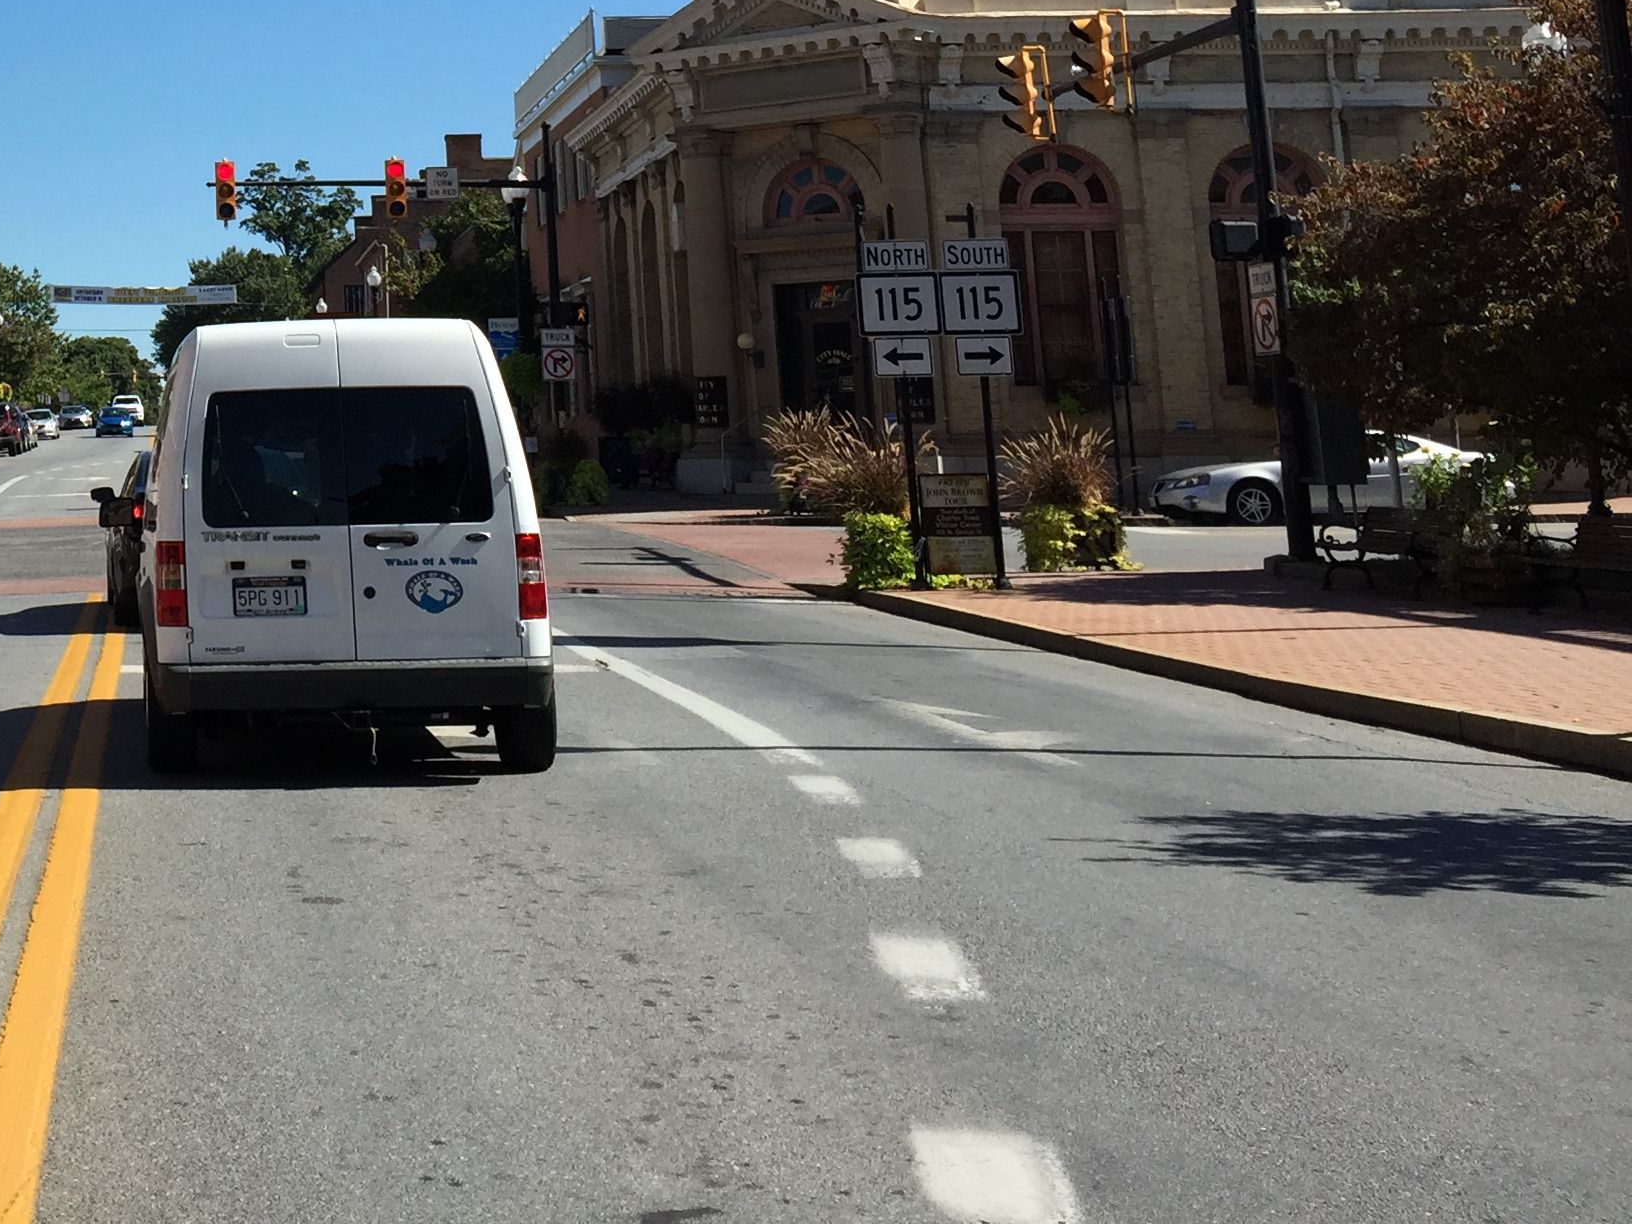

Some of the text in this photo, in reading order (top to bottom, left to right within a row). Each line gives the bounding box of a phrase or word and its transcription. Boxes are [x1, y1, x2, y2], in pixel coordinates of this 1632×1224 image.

[436, 170, 448, 178] NO
[442, 188, 457, 196] RED
[867, 246, 926, 266] NORTH
[947, 244, 1006, 265] SOUTH
[875, 287, 923, 321] 115
[956, 286, 1004, 320] 115
[545, 333, 571, 342] TRUCK
[926, 487, 984, 498] JOHN BROWN
[945, 497, 968, 506] TOUR
[201, 531, 270, 542] TRANSIT
[384, 556, 478, 567] Whale Of A Wash
[237, 588, 301, 607] 5PG 911
